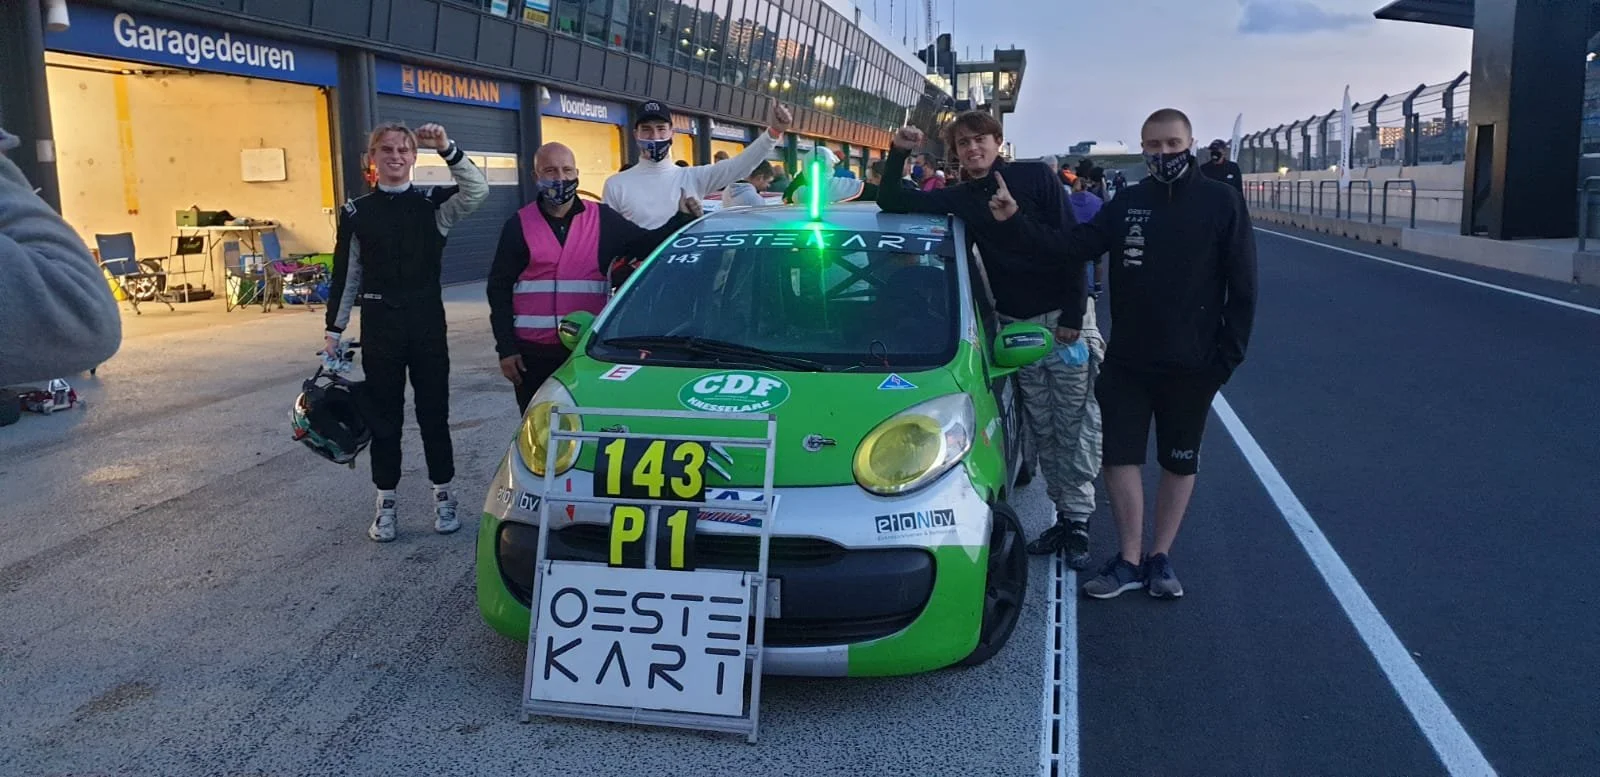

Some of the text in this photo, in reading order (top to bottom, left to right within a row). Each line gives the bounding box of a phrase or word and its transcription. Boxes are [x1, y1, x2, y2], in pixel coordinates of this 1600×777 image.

[113, 12, 295, 71] Garagedeuren
[417, 68, 500, 104] HÖRMANN
[559, 94, 608, 119] Voordeuren
[667, 253, 698, 264] 143
[671, 232, 943, 251] OESTE KART
[693, 374, 783, 397] CDF
[605, 438, 706, 499] 143
[610, 505, 689, 569] P 1
[550, 587, 744, 640] OESTE
[544, 635, 741, 697] KART
